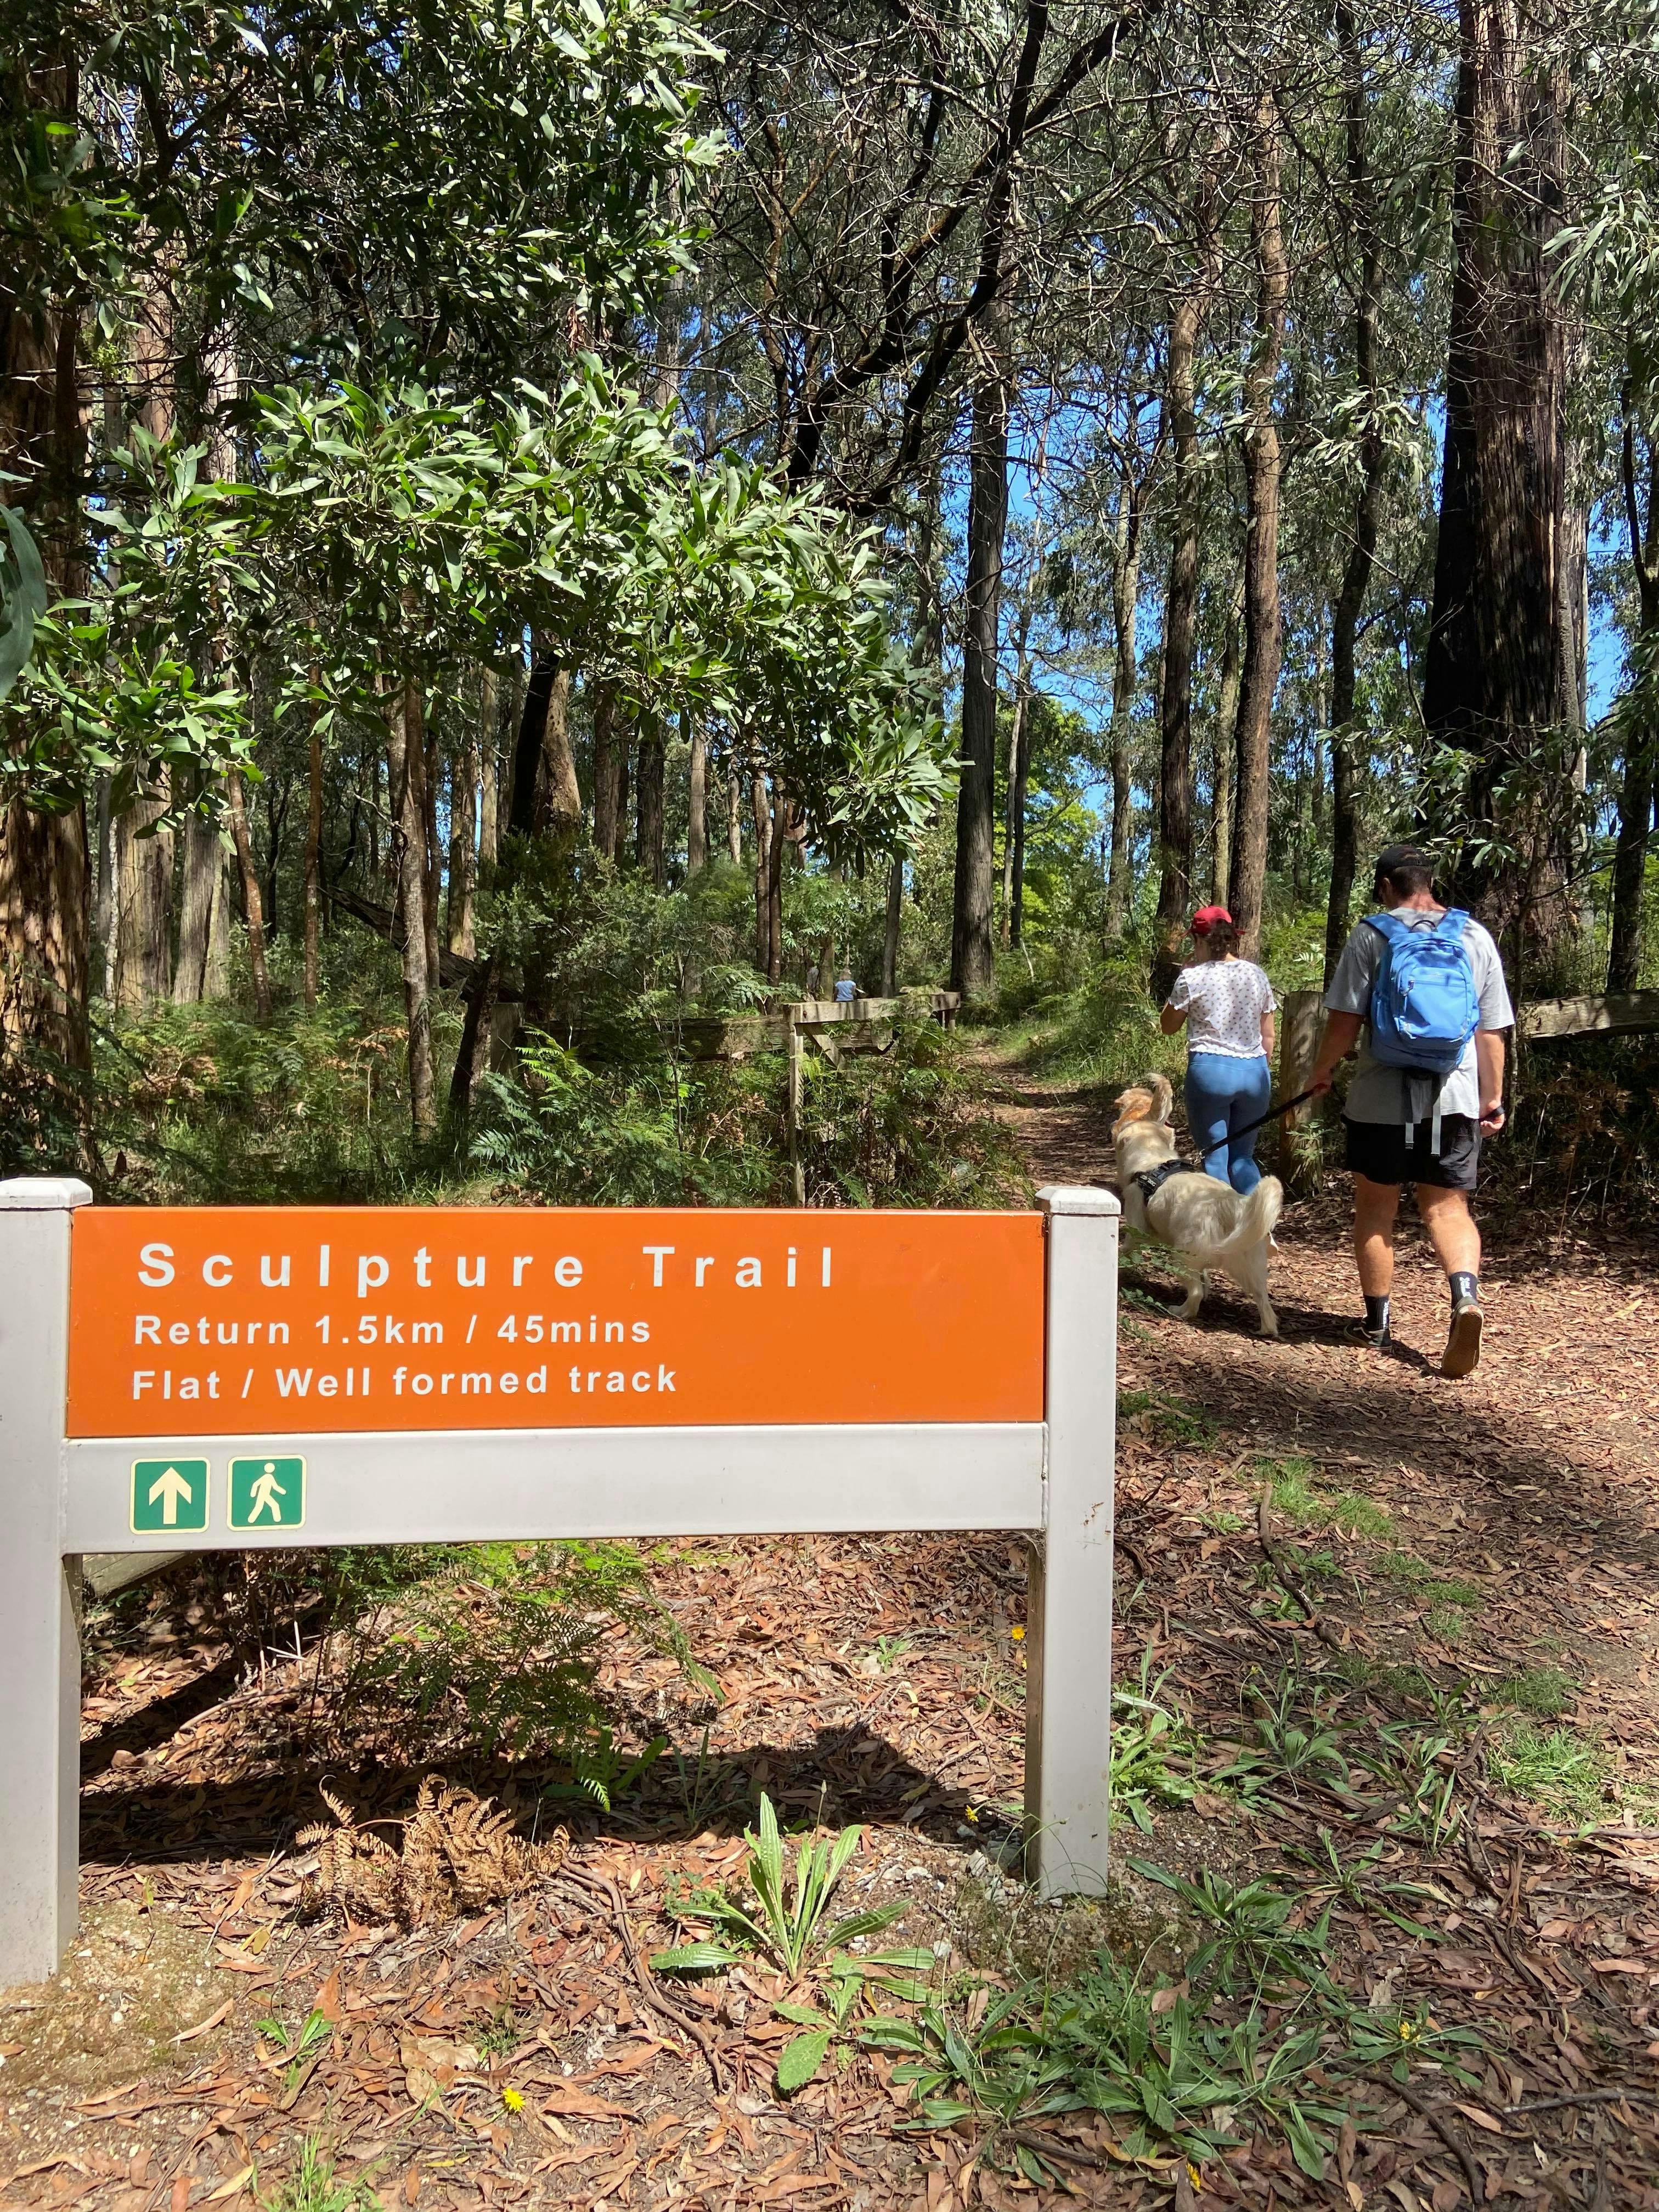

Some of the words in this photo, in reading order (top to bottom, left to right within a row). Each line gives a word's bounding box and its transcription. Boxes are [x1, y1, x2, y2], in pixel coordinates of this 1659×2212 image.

[138, 1243, 583, 1298] Sculpture
[642, 1246, 831, 1288] Trail
[135, 1315, 289, 1345] Return
[315, 1315, 443, 1344] 1.5km
[466, 1314, 477, 1344] /
[497, 1314, 650, 1344] 45mins
[133, 1370, 220, 1400] Flat
[241, 1369, 253, 1398] /
[275, 1367, 370, 1397] Well
[392, 1365, 547, 1395] formed
[569, 1364, 676, 1393] track
